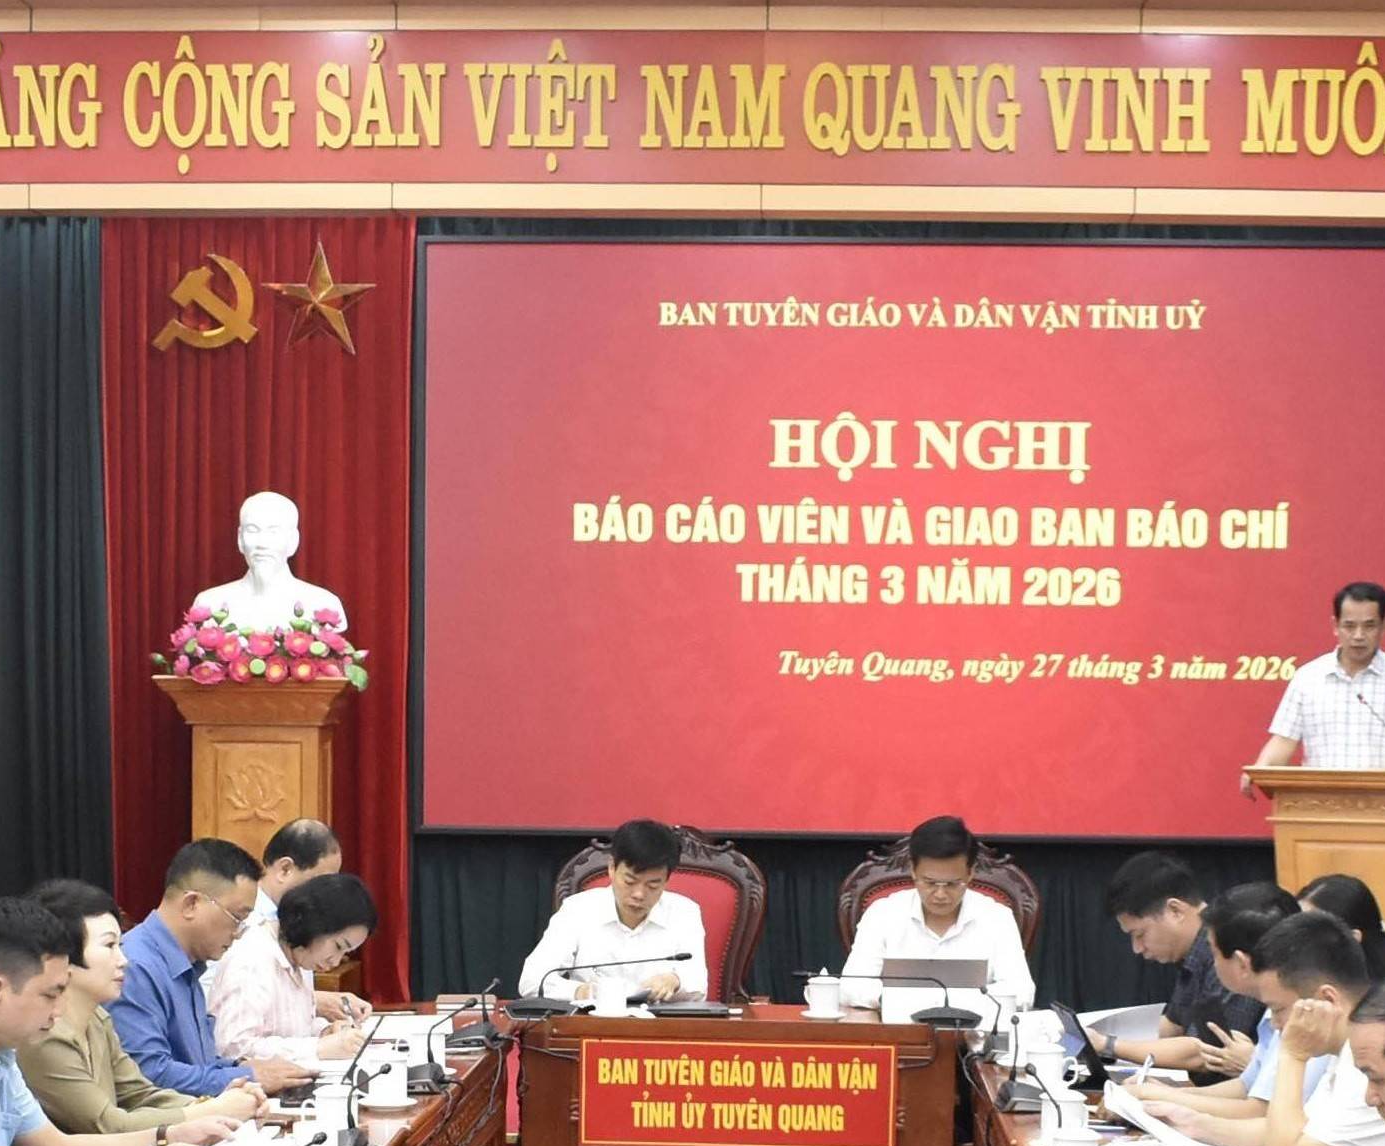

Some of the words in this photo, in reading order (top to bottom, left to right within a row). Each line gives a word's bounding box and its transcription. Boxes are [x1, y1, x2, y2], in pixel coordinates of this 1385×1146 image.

[124, 36, 295, 174] CỘNG
[315, 34, 447, 149] SẢN
[463, 39, 615, 171] VIỆT
[639, 64, 786, 147] NAM
[803, 63, 1021, 156] QUANG
[1038, 60, 1211, 152] VINH
[660, 302, 717, 325] BAN
[723, 296, 820, 326] TUYÊN
[827, 297, 901, 327] GIÁO
[907, 297, 947, 327] VÀ
[955, 297, 1014, 327] DÂN
[1020, 301, 1080, 334] VẬN
[1087, 298, 1158, 329] TỈNH
[769, 412, 897, 481] HỘI
[914, 420, 1091, 484] NGHỊ
[574, 495, 653, 542] BÁO
[666, 496, 745, 543] CÁO
[757, 497, 849, 544] VIÊN
[861, 498, 913, 544] VÀ
[925, 506, 1018, 546] GIAO
[1031, 507, 1115, 546] BAN
[1127, 501, 1208, 548] BÁO
[1220, 502, 1289, 549] CHÍ
[736, 556, 868, 603] THÁNG
[880, 566, 905, 604] 3
[917, 558, 1011, 605] NĂM
[1022, 567, 1121, 606] 2026
[779, 651, 854, 680] Tuyên
[862, 652, 954, 682] Quang,
[962, 653, 1024, 683] ngày
[1030, 654, 1064, 677] 27
[1068, 655, 1142, 684] tháng
[1148, 655, 1164, 678] 3
[1170, 656, 1227, 679] năm
[1233, 656, 1297, 681] 2026
[599, 1059, 637, 1084] BAN
[644, 1055, 704, 1085] TUYÊN
[711, 1055, 755, 1086] GIÁO
[761, 1057, 785, 1087] VÀ
[792, 1057, 832, 1088] DÂN
[838, 1058, 876, 1094] VẬN
[632, 1092, 675, 1127] TỈNH
[682, 1093, 705, 1128] ỦY
[712, 1098, 772, 1129] TUYÊN
[779, 1105, 843, 1132] QUANG
